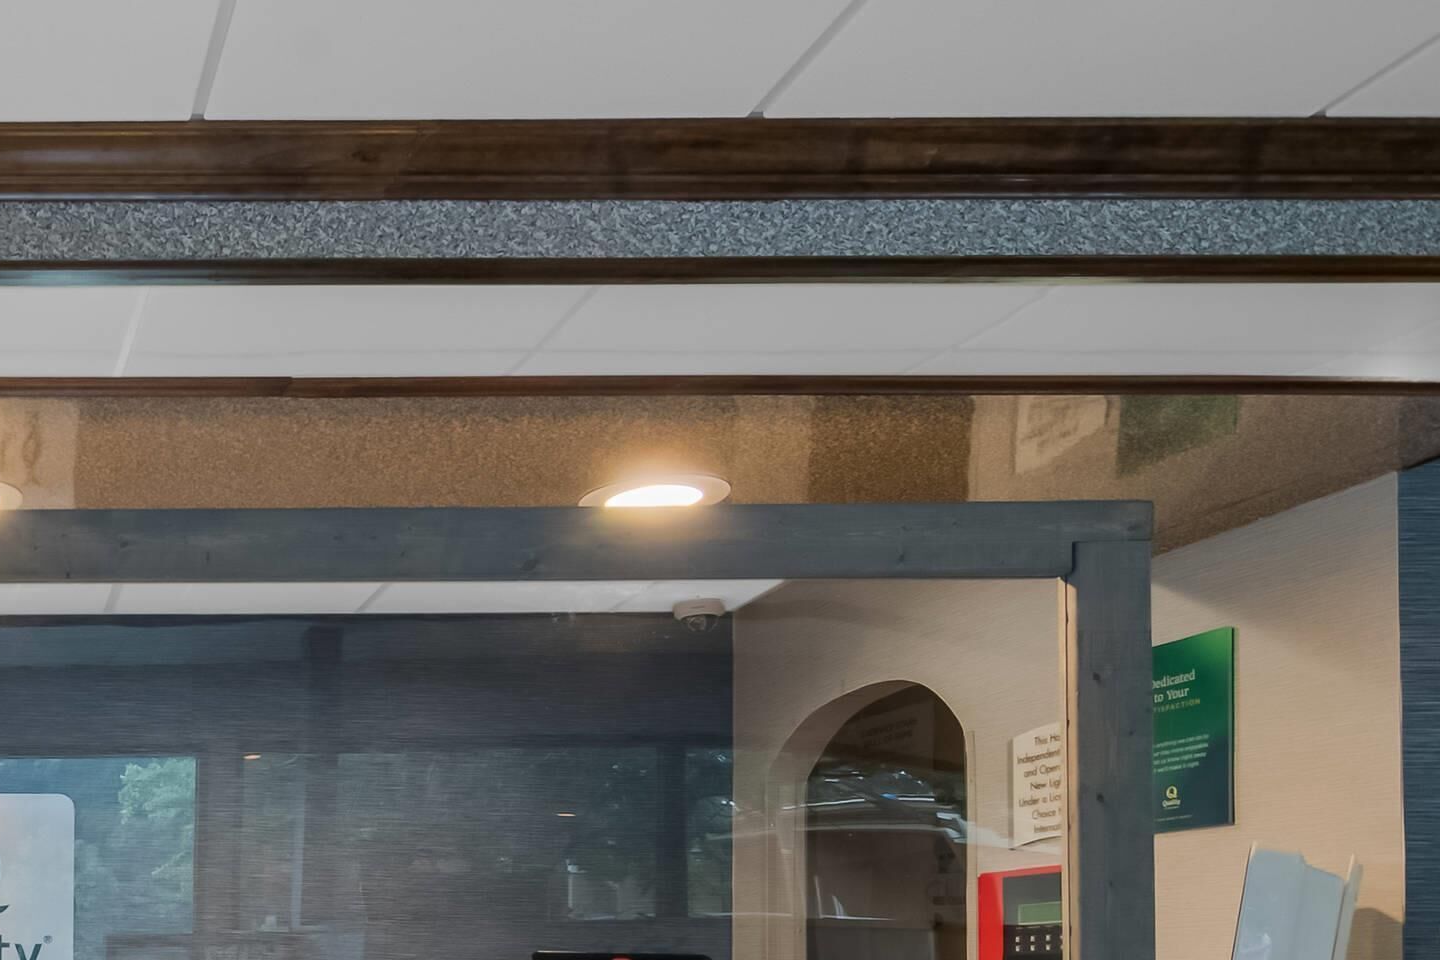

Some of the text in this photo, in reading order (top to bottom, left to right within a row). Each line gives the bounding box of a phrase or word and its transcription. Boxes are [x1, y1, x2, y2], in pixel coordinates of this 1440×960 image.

[1154, 688, 1190, 703] to Your
[1023, 766, 1038, 778] and
[1030, 781, 1047, 790] New
[1019, 795, 1040, 807] Under
